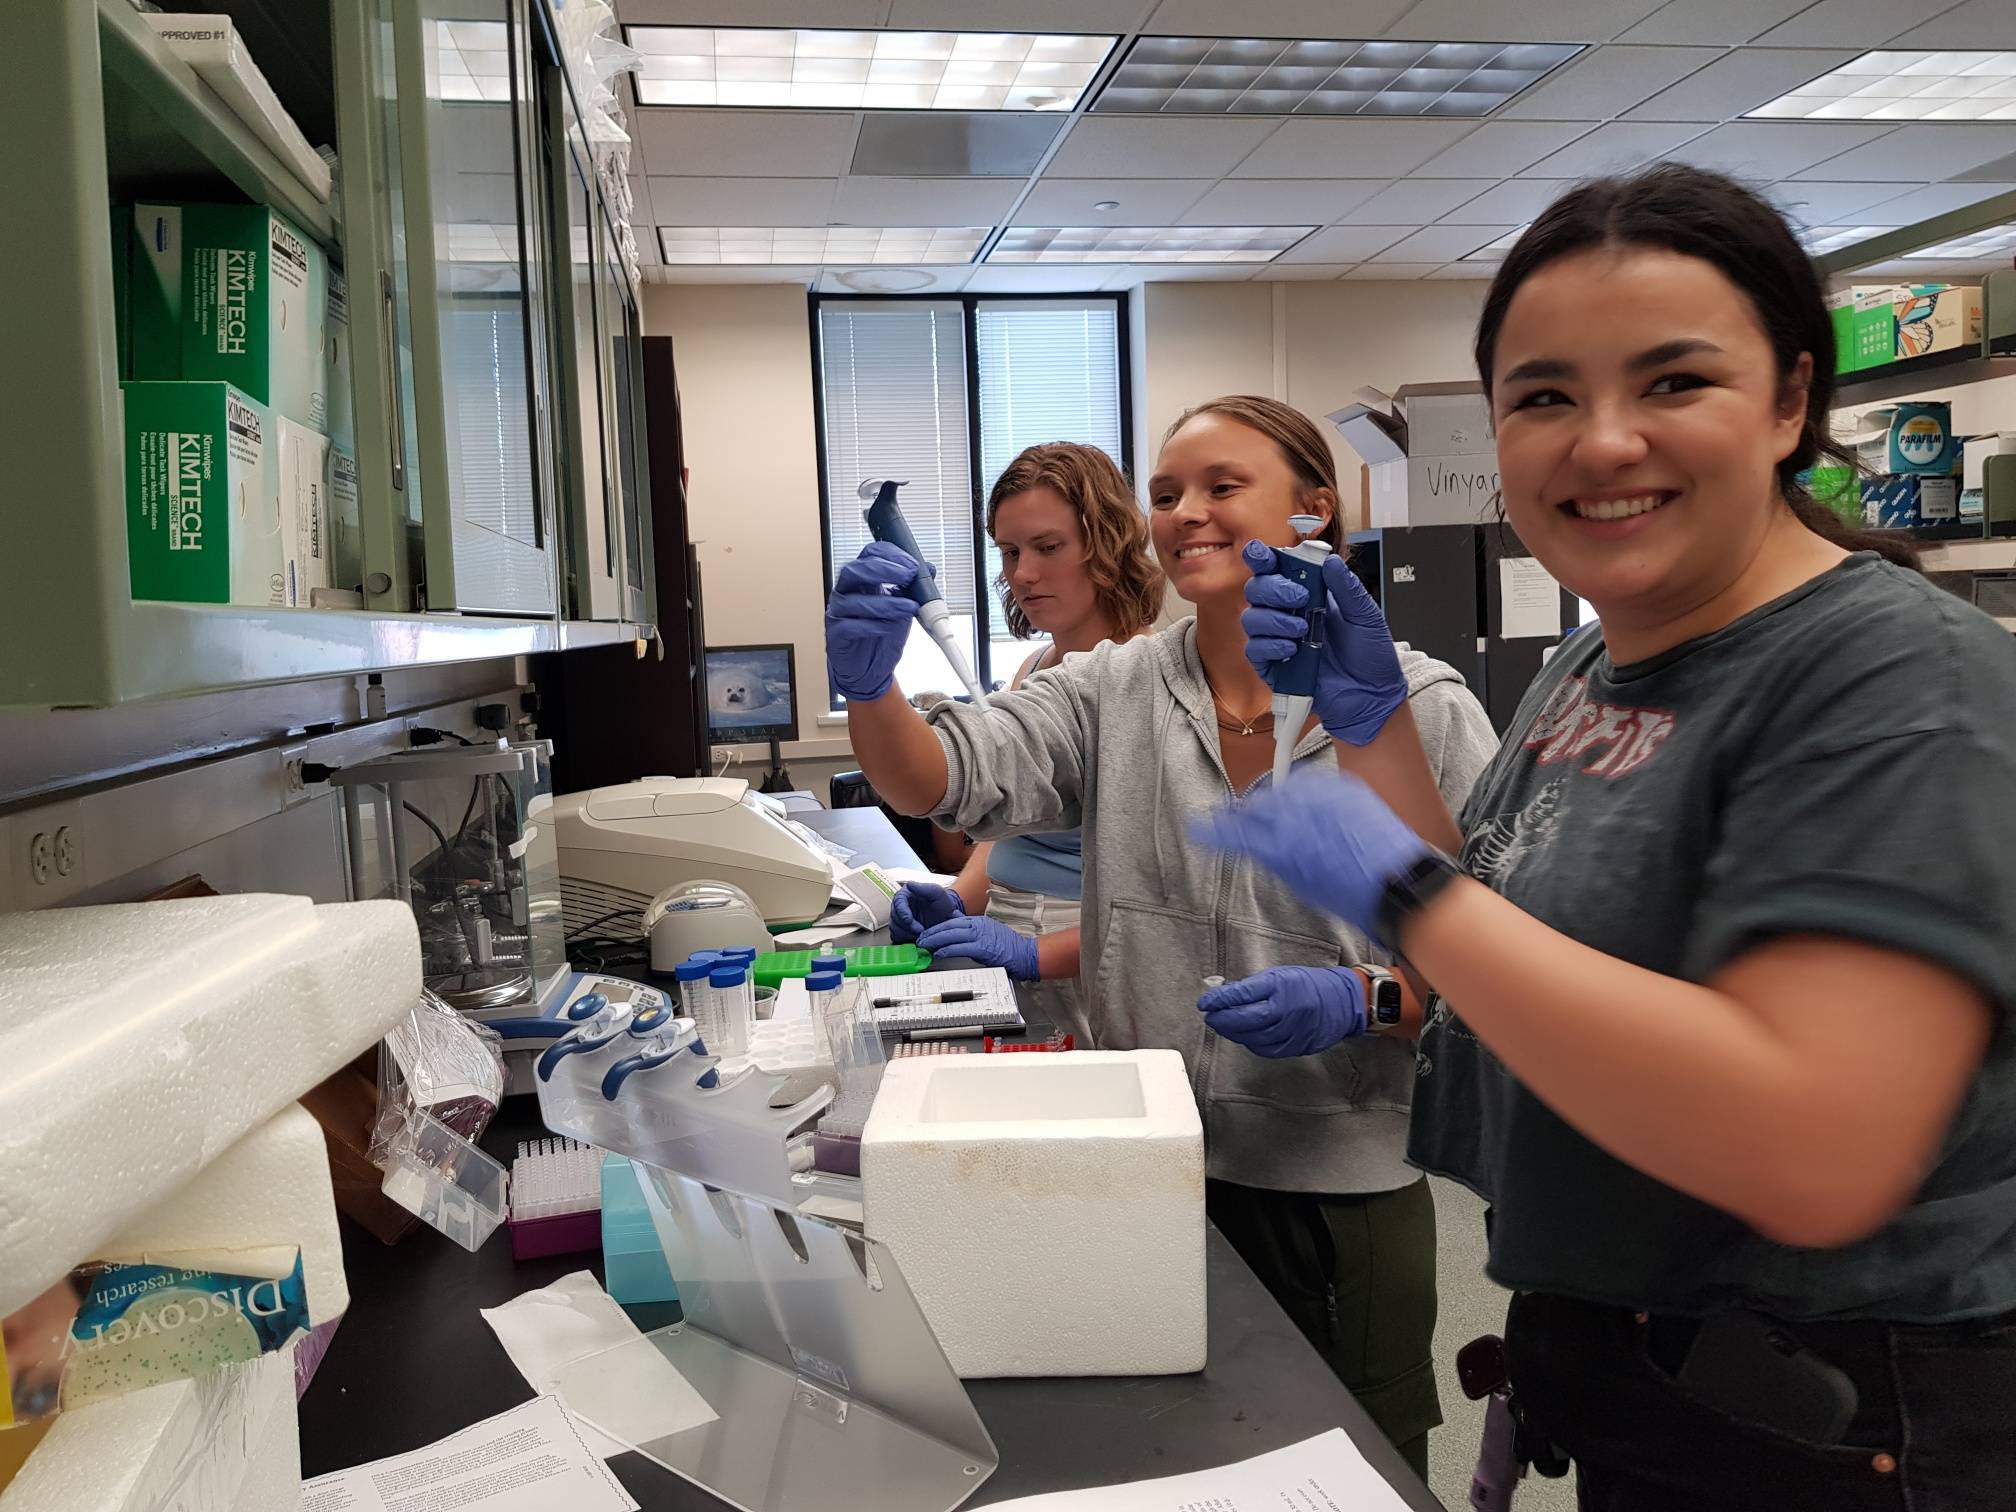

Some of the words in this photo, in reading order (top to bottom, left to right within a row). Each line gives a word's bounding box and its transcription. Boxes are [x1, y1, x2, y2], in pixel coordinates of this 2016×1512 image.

[158, 30, 212, 40] PPROVED
[271, 222, 307, 263] KIMTECH
[246, 250, 257, 291] Kimwipes
[228, 249, 246, 354] KIMTECH
[228, 399, 261, 434] KIMTECH
[202, 434, 214, 480] Kimwipes
[1899, 433, 1941, 445] PARAFILM
[179, 433, 203, 550] KIMTECH
[1427, 462, 1499, 507] Vinyar
[170, 494, 179, 526] SCIENCE
[96, 1272, 175, 1308] research
